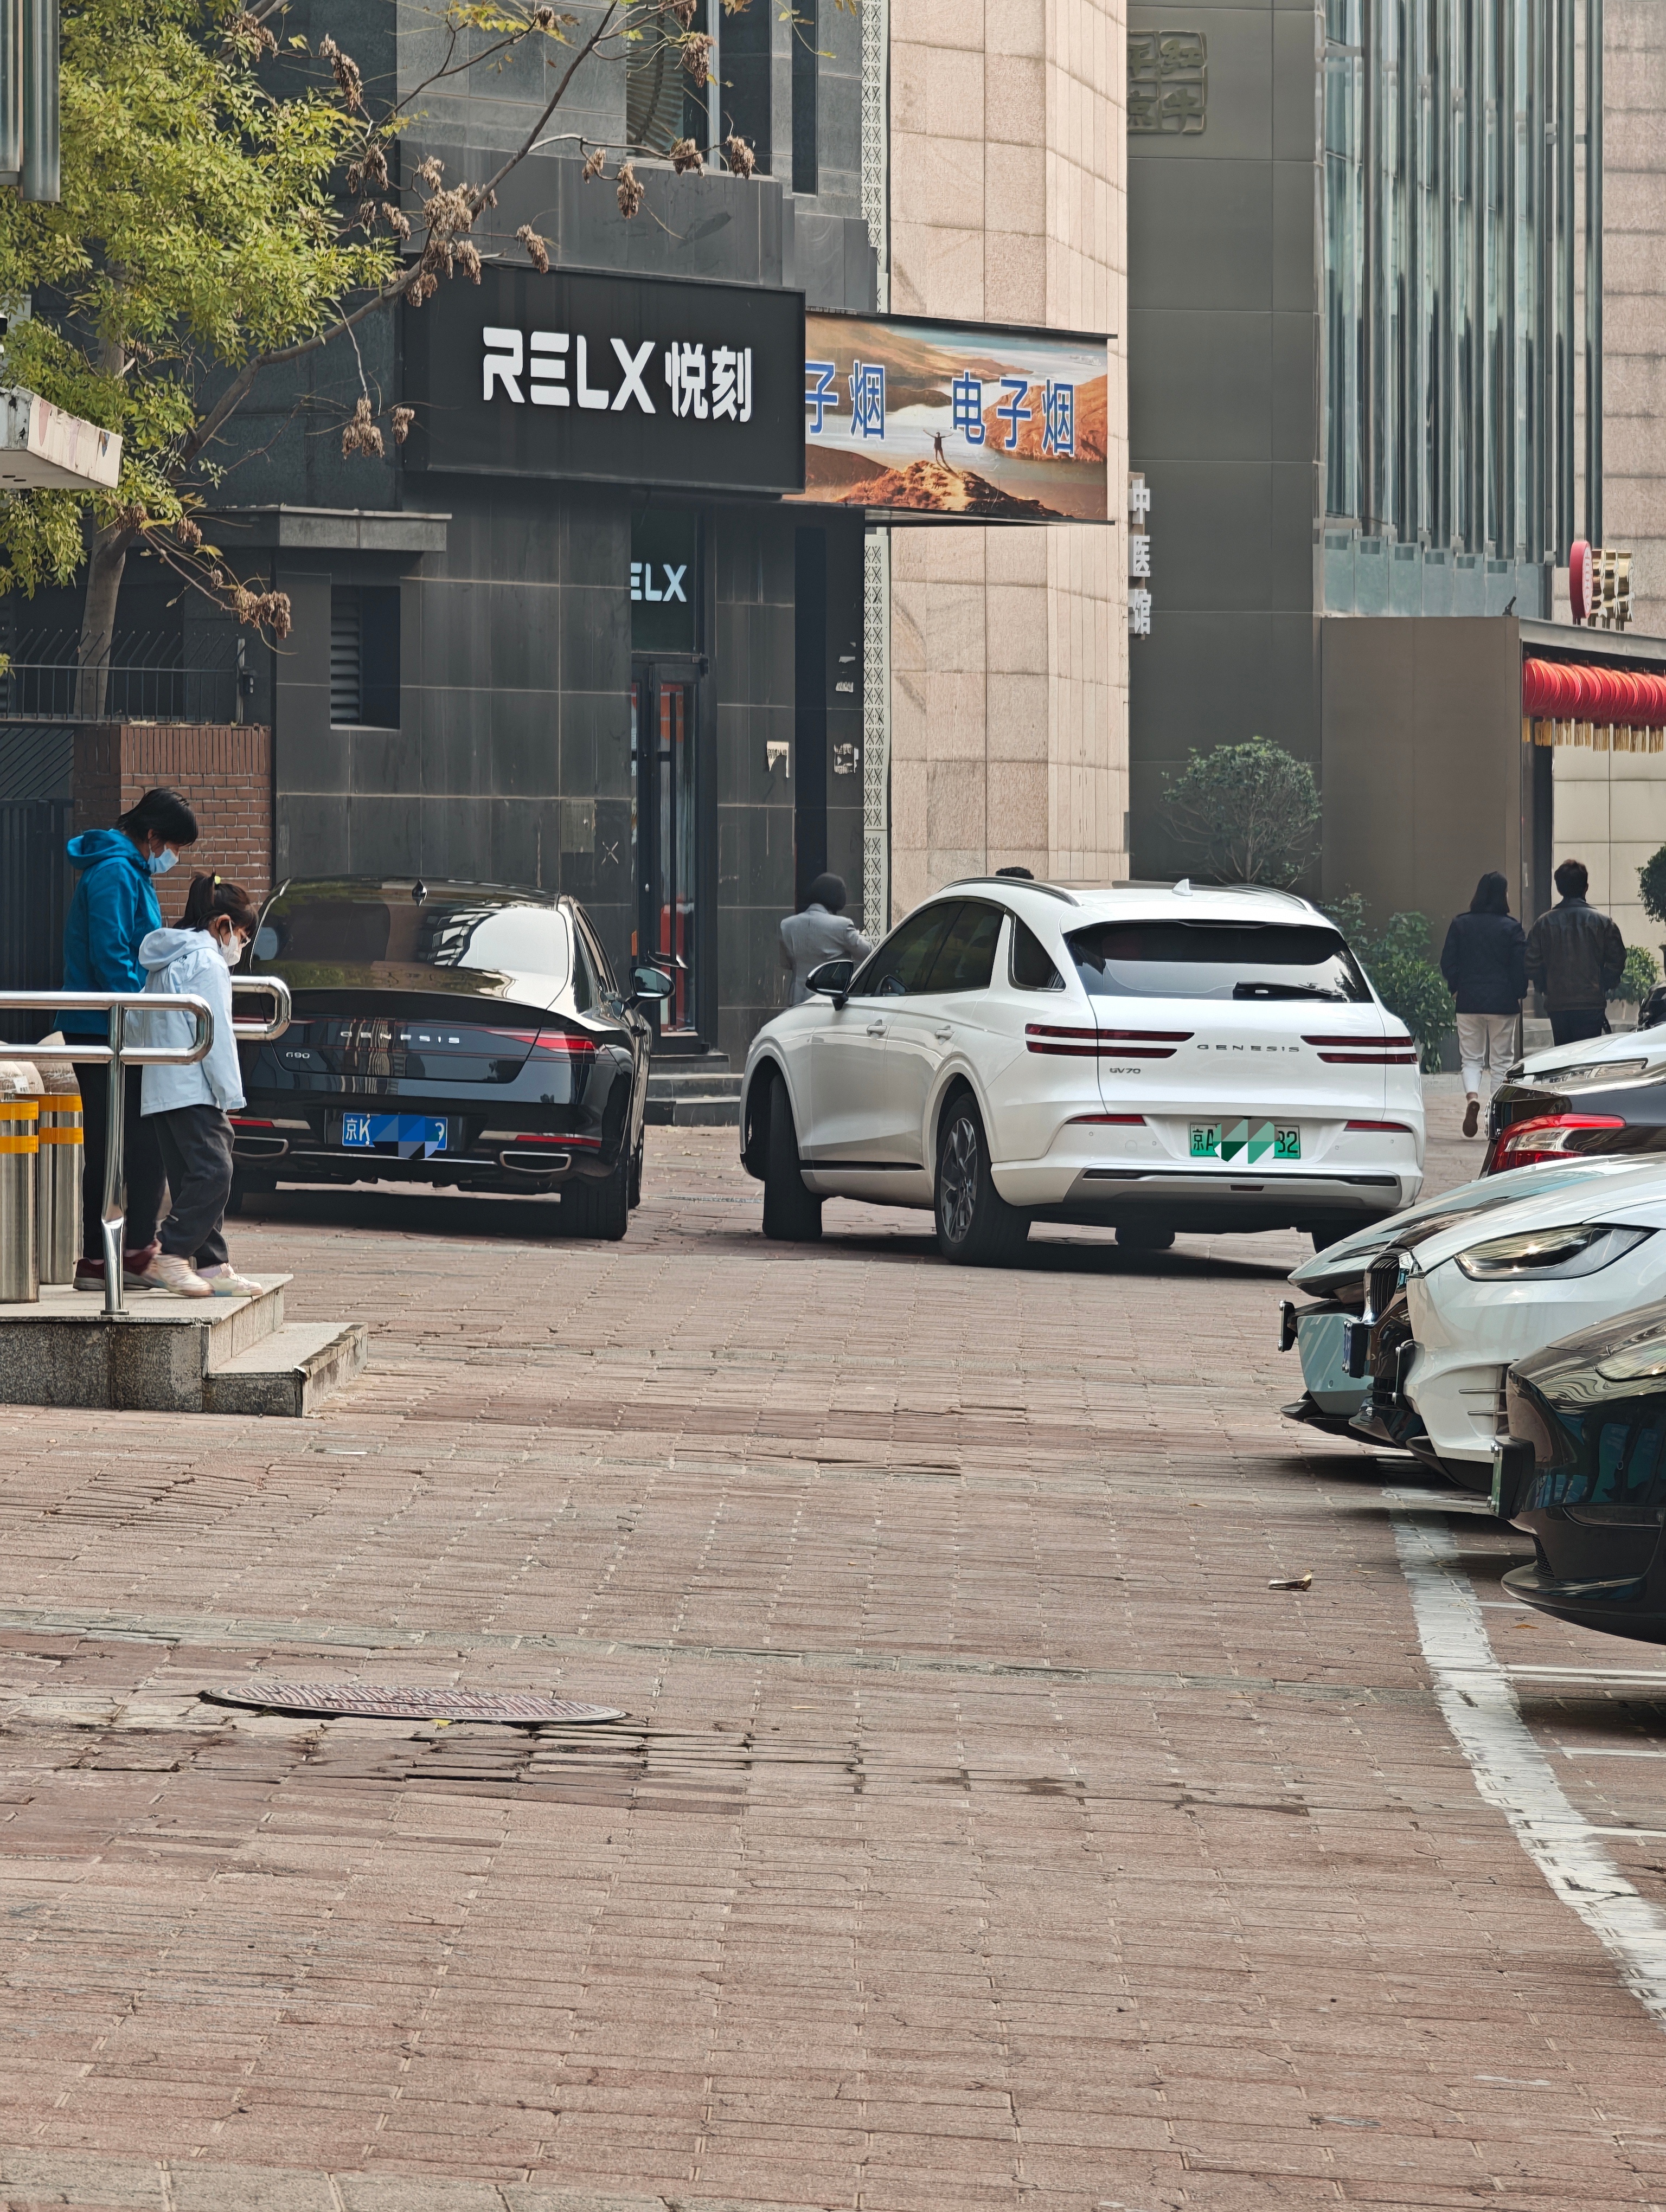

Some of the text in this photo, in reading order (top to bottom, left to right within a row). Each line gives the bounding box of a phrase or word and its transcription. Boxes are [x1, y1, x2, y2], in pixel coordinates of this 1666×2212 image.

[483, 326, 753, 422] RELX 悦刻
[952, 370, 1075, 457] 电子烟
[1196, 1044, 1300, 1052] GENESIS
